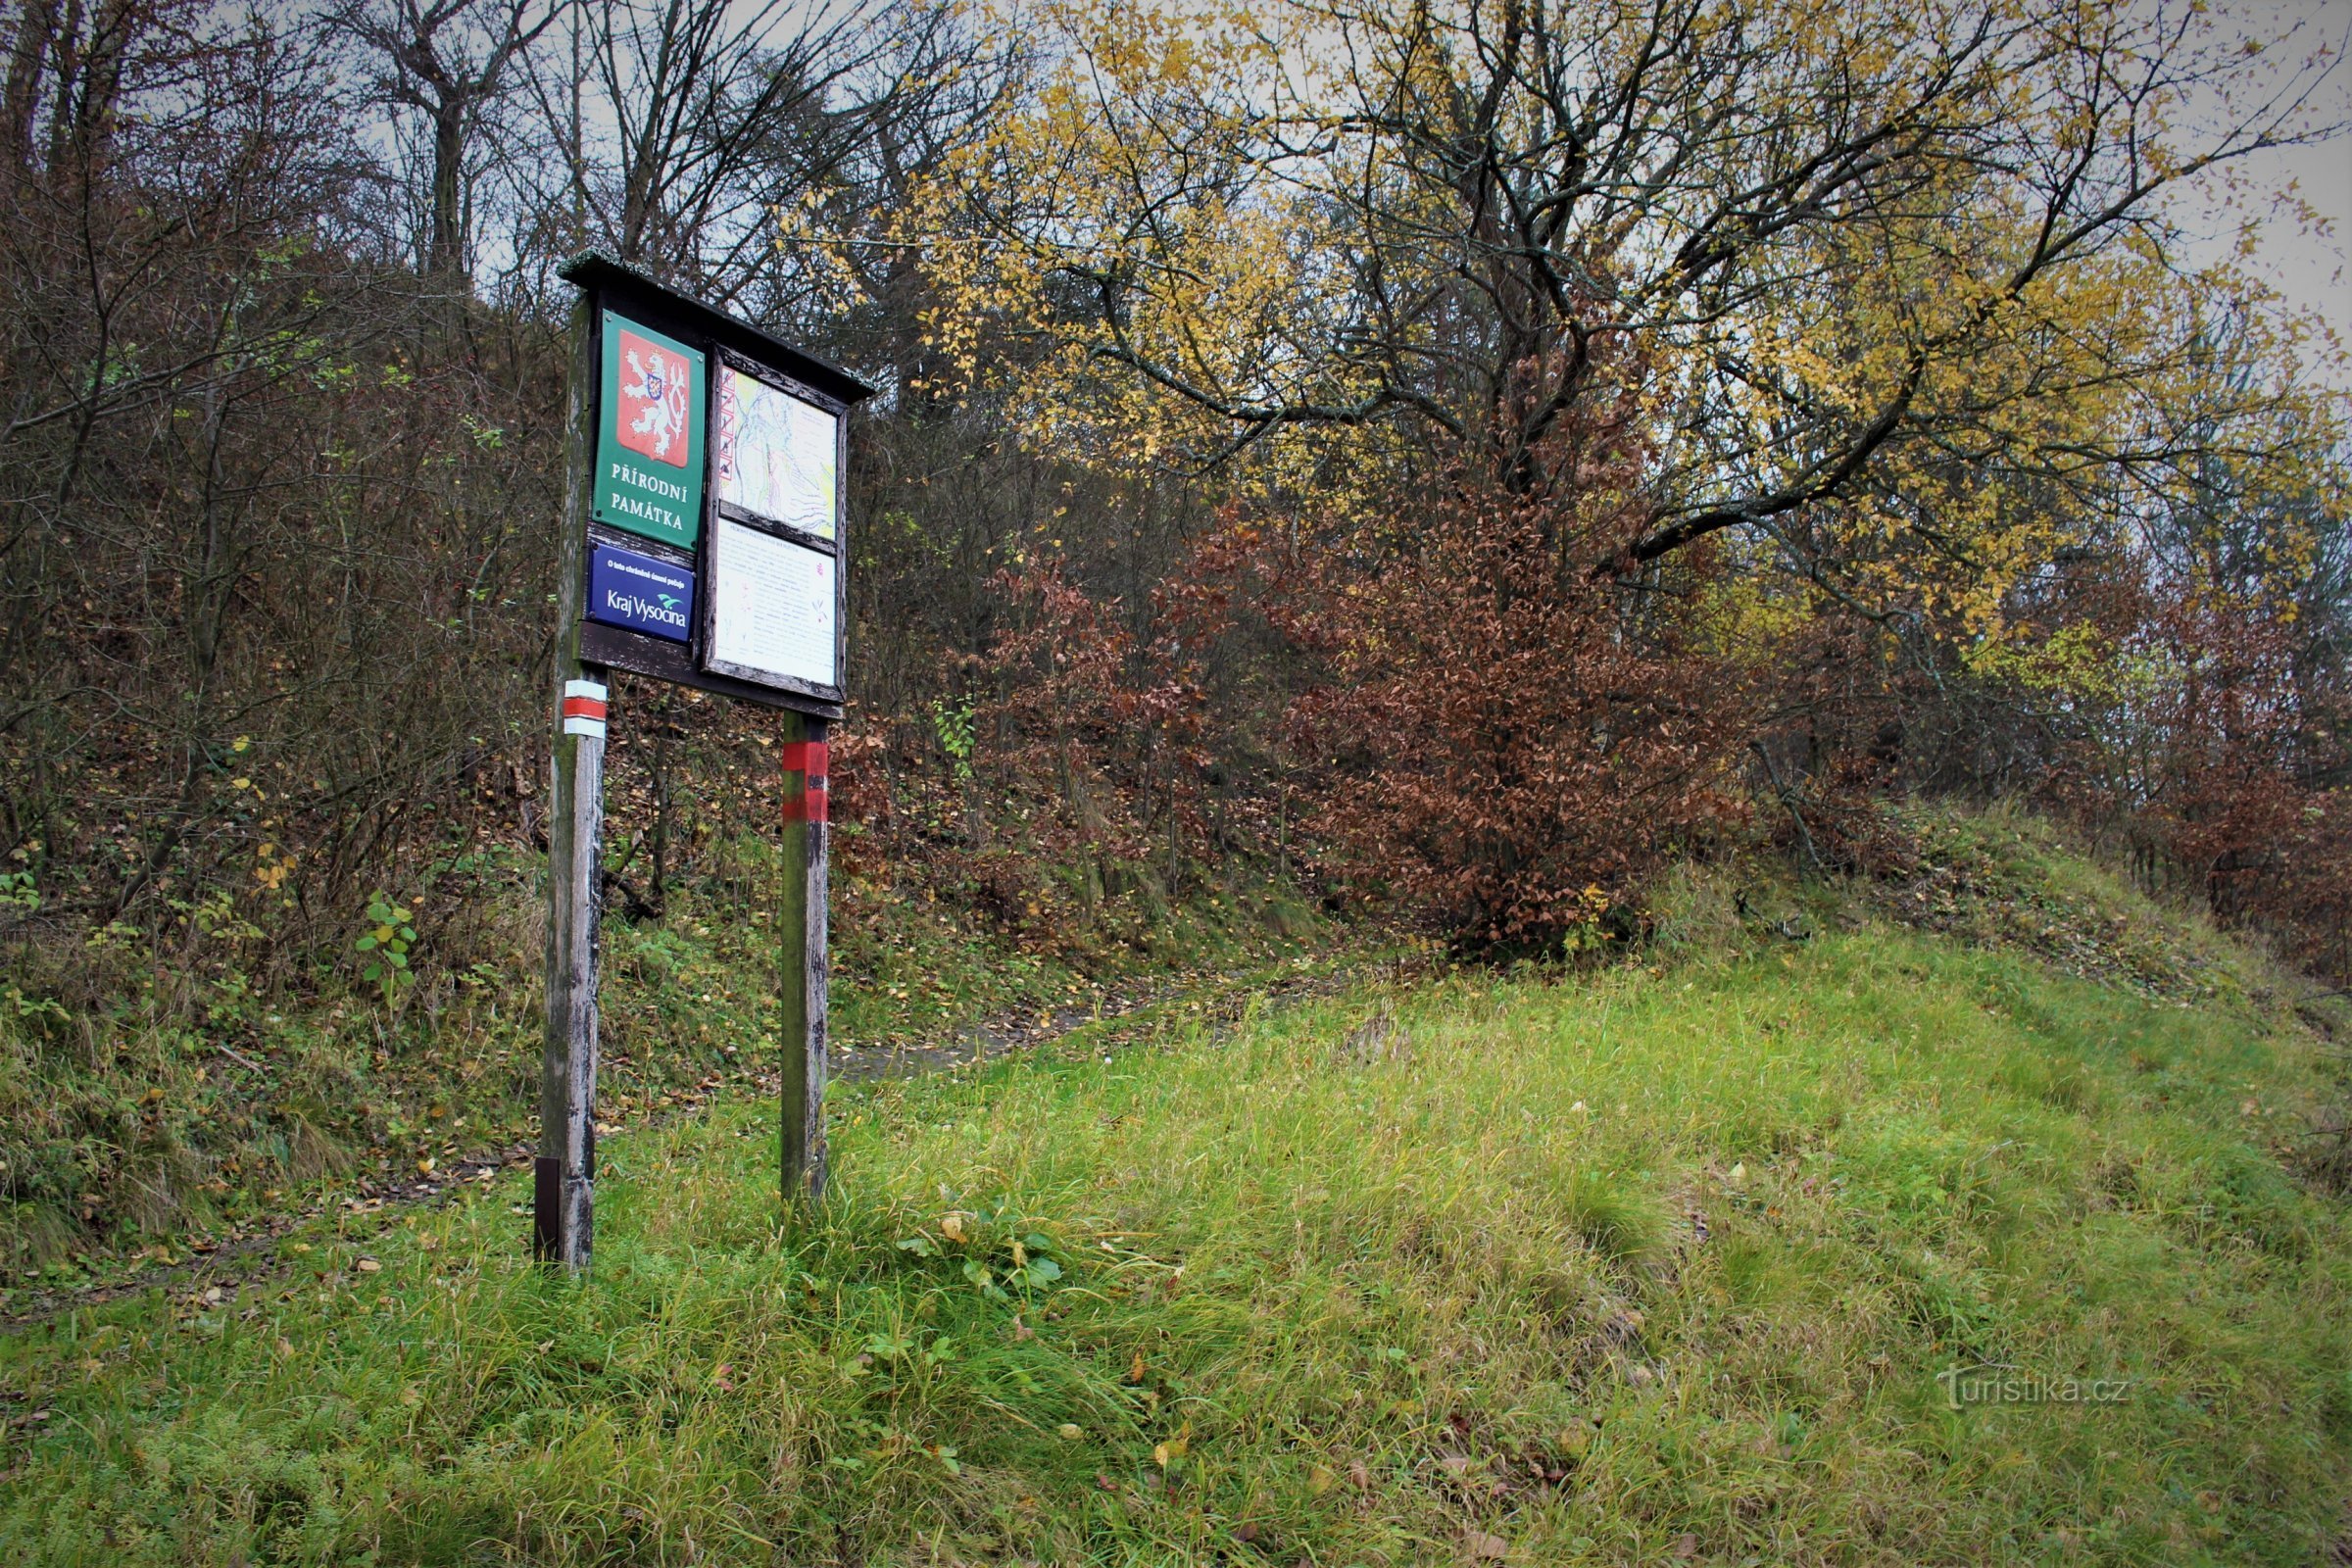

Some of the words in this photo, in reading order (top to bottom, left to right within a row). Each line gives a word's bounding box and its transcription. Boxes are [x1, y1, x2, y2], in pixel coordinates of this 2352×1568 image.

[612, 463, 687, 503] PŘÍRODNÍ
[611, 492, 683, 530] PAMÁTKA
[608, 589, 632, 617] Kraj
